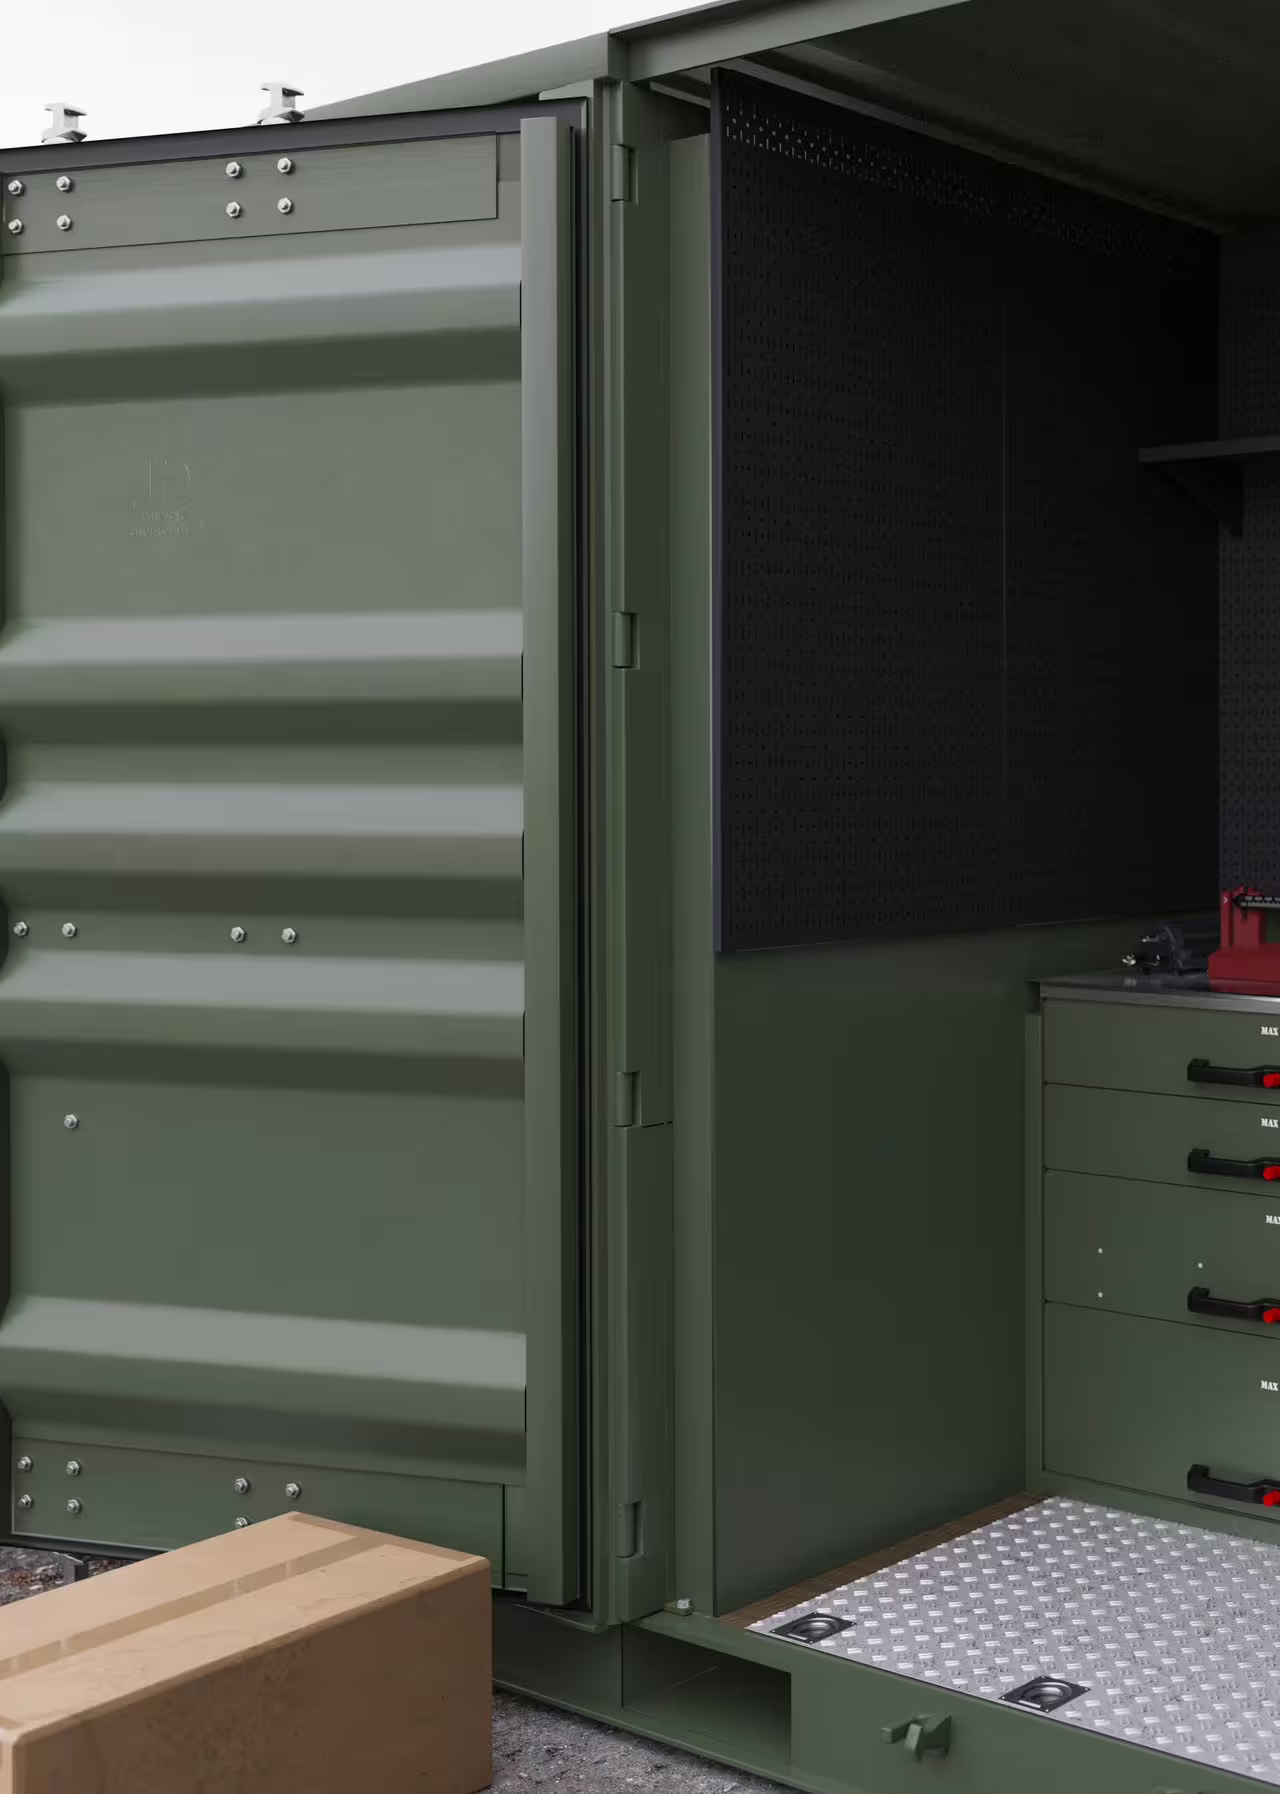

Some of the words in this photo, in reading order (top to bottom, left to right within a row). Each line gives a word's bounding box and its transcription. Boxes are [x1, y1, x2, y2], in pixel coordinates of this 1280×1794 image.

[1260, 1026, 1279, 1036] MAX
[1261, 1118, 1279, 1128] MAX
[1260, 1380, 1279, 1391] MAX
